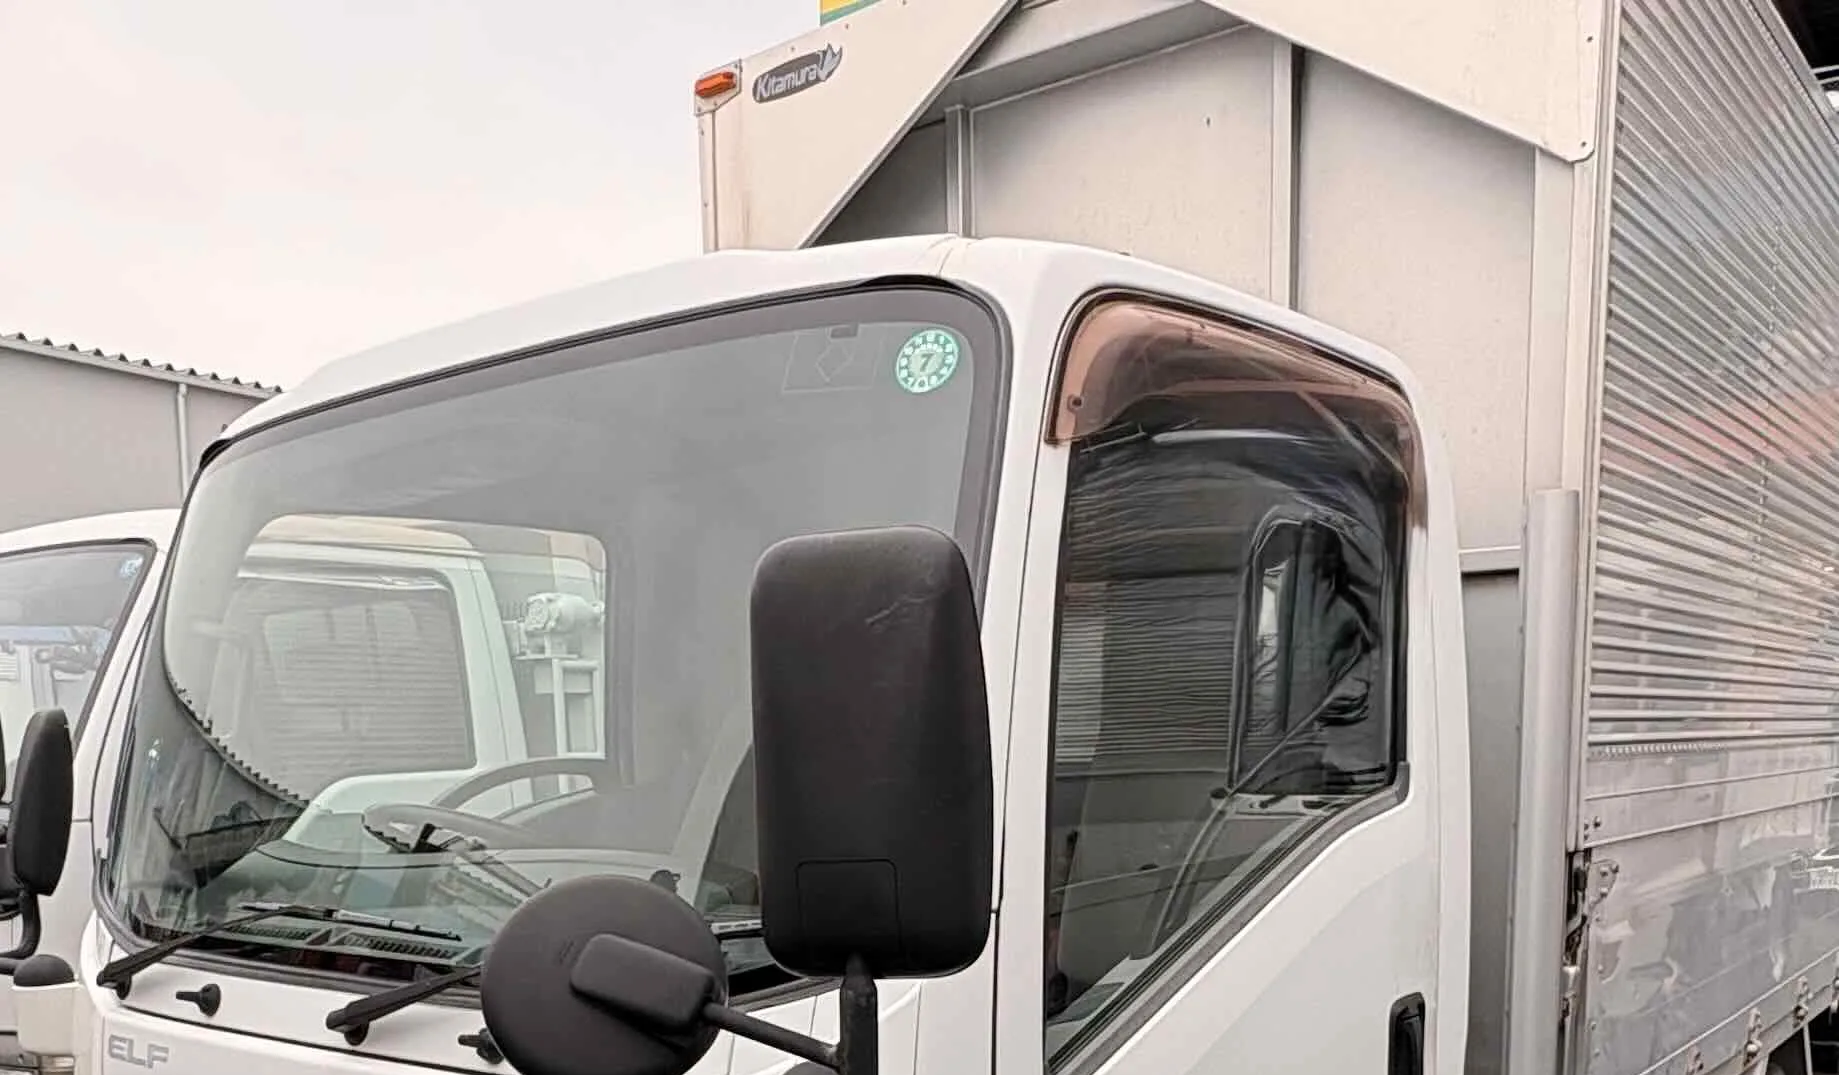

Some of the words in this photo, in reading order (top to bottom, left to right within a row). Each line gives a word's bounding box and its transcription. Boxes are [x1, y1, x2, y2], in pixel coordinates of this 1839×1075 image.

[756, 63, 818, 101] Kitamura
[920, 352, 935, 372] 7
[109, 1034, 169, 1069] ELF
